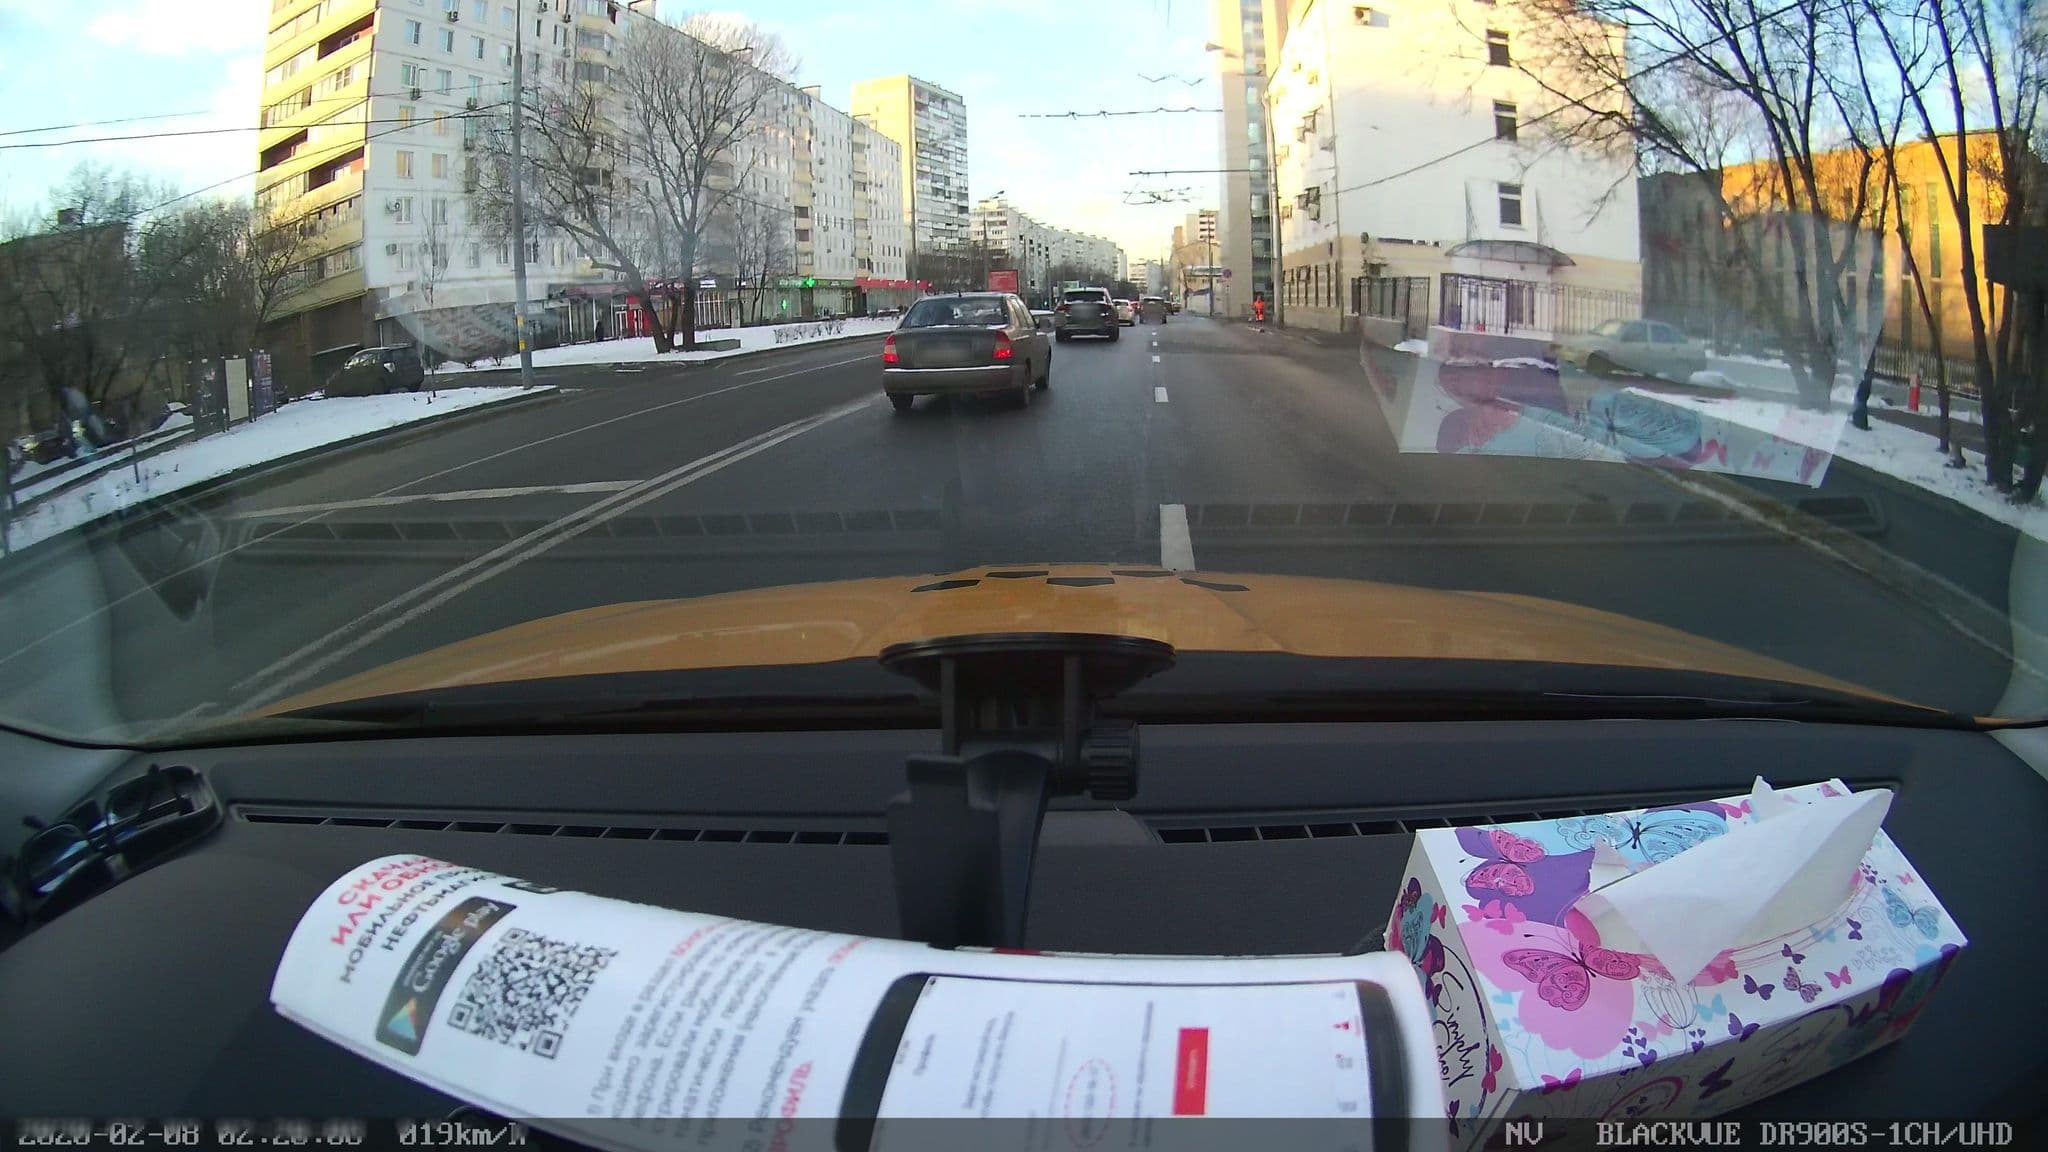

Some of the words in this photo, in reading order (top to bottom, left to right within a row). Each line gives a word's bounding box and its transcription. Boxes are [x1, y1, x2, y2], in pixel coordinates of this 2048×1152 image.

[331, 893, 382, 946] ИЛИ
[340, 878, 435, 984] МОБИЛЬНОЕ
[411, 927, 465, 993] Google
[1438, 971, 1480, 1088] Simply
